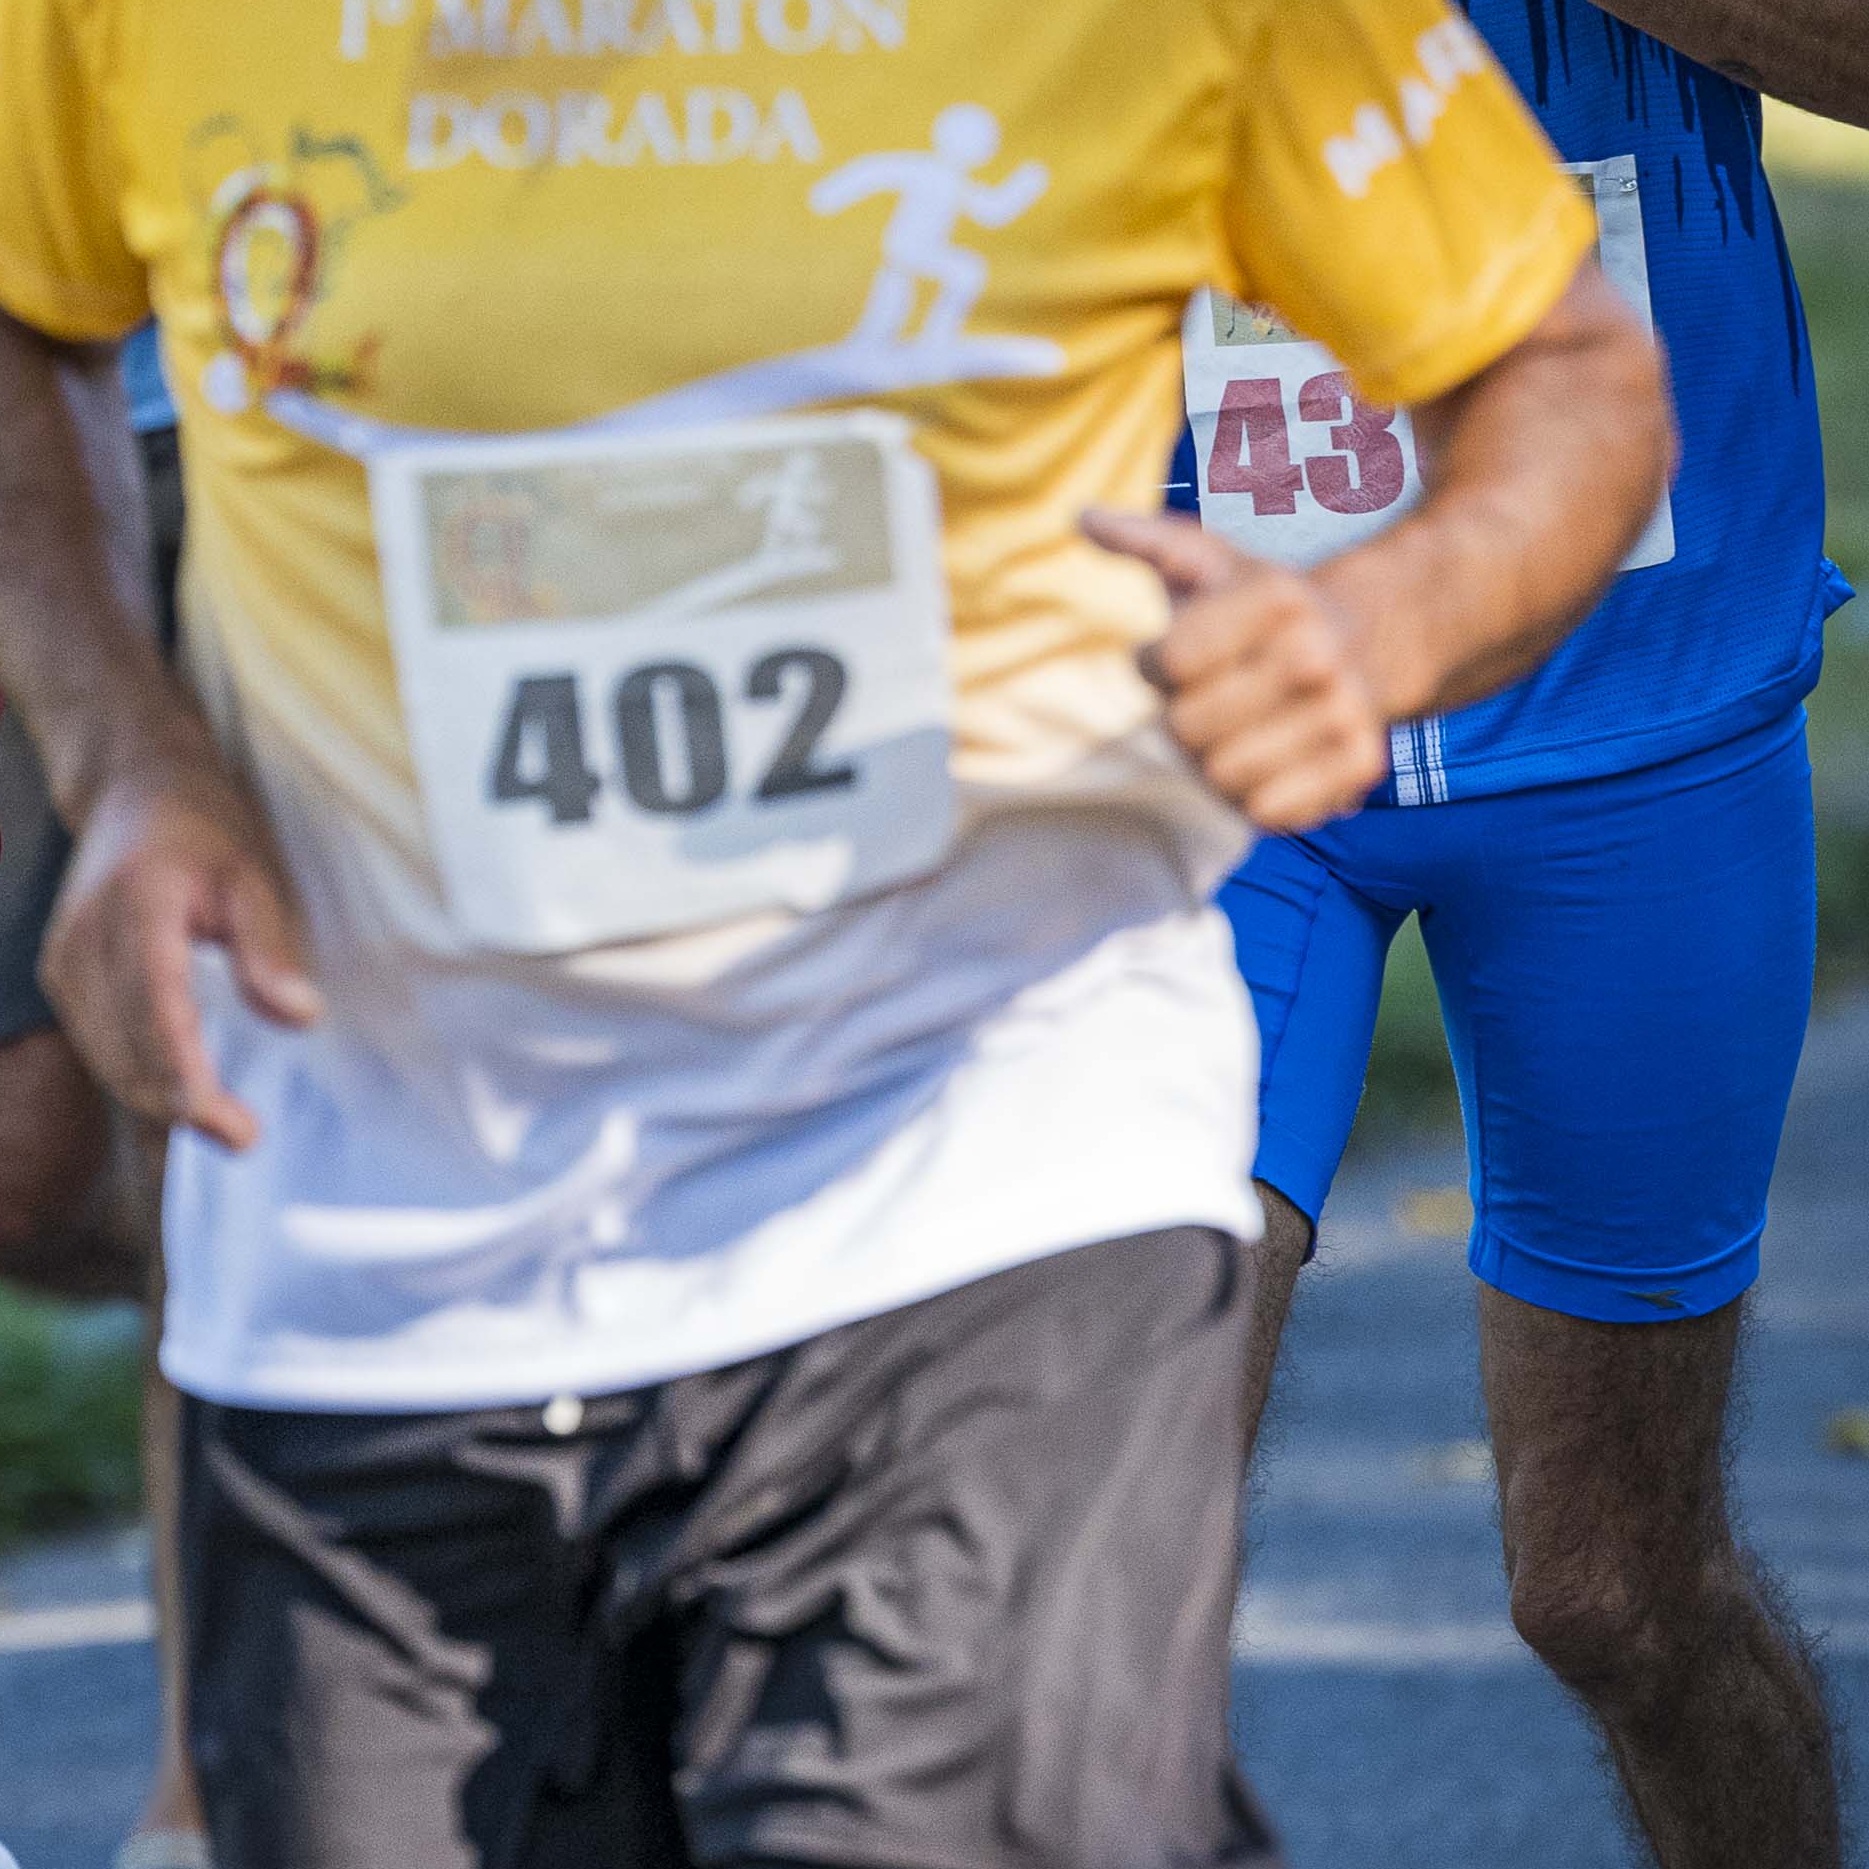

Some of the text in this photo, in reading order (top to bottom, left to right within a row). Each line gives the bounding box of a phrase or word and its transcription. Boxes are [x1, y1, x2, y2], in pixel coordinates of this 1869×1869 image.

[405, 85, 825, 173] DORADA
[1207, 369, 1435, 516] 43
[488, 643, 861, 824] 402
